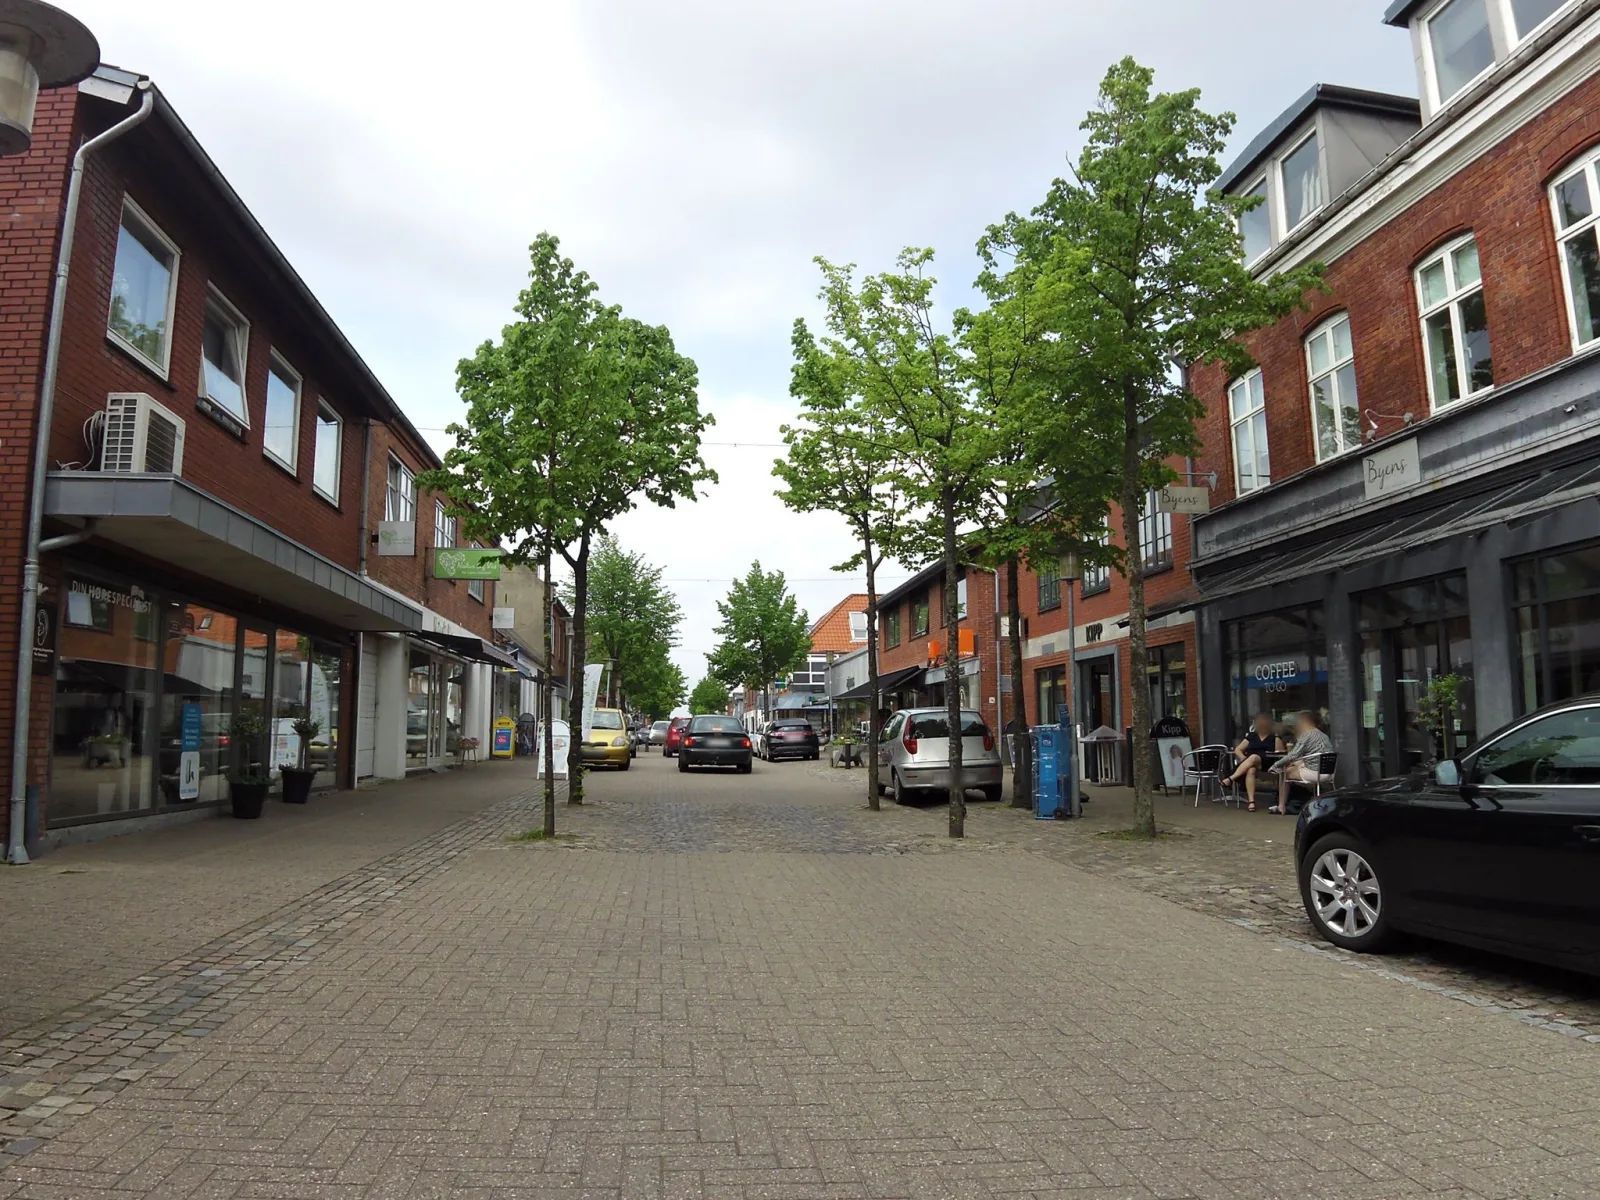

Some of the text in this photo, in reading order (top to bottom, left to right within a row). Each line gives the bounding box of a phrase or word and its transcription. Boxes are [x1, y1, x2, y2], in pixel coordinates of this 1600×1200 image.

[1366, 458, 1408, 490] Byens
[1161, 488, 1198, 510] Byens
[72, 580, 152, 614] DIN HØRESPECIAST
[1255, 660, 1296, 681] COFFEE
[1264, 680, 1287, 693] TO GO
[1161, 724, 1182, 736] Kipp
